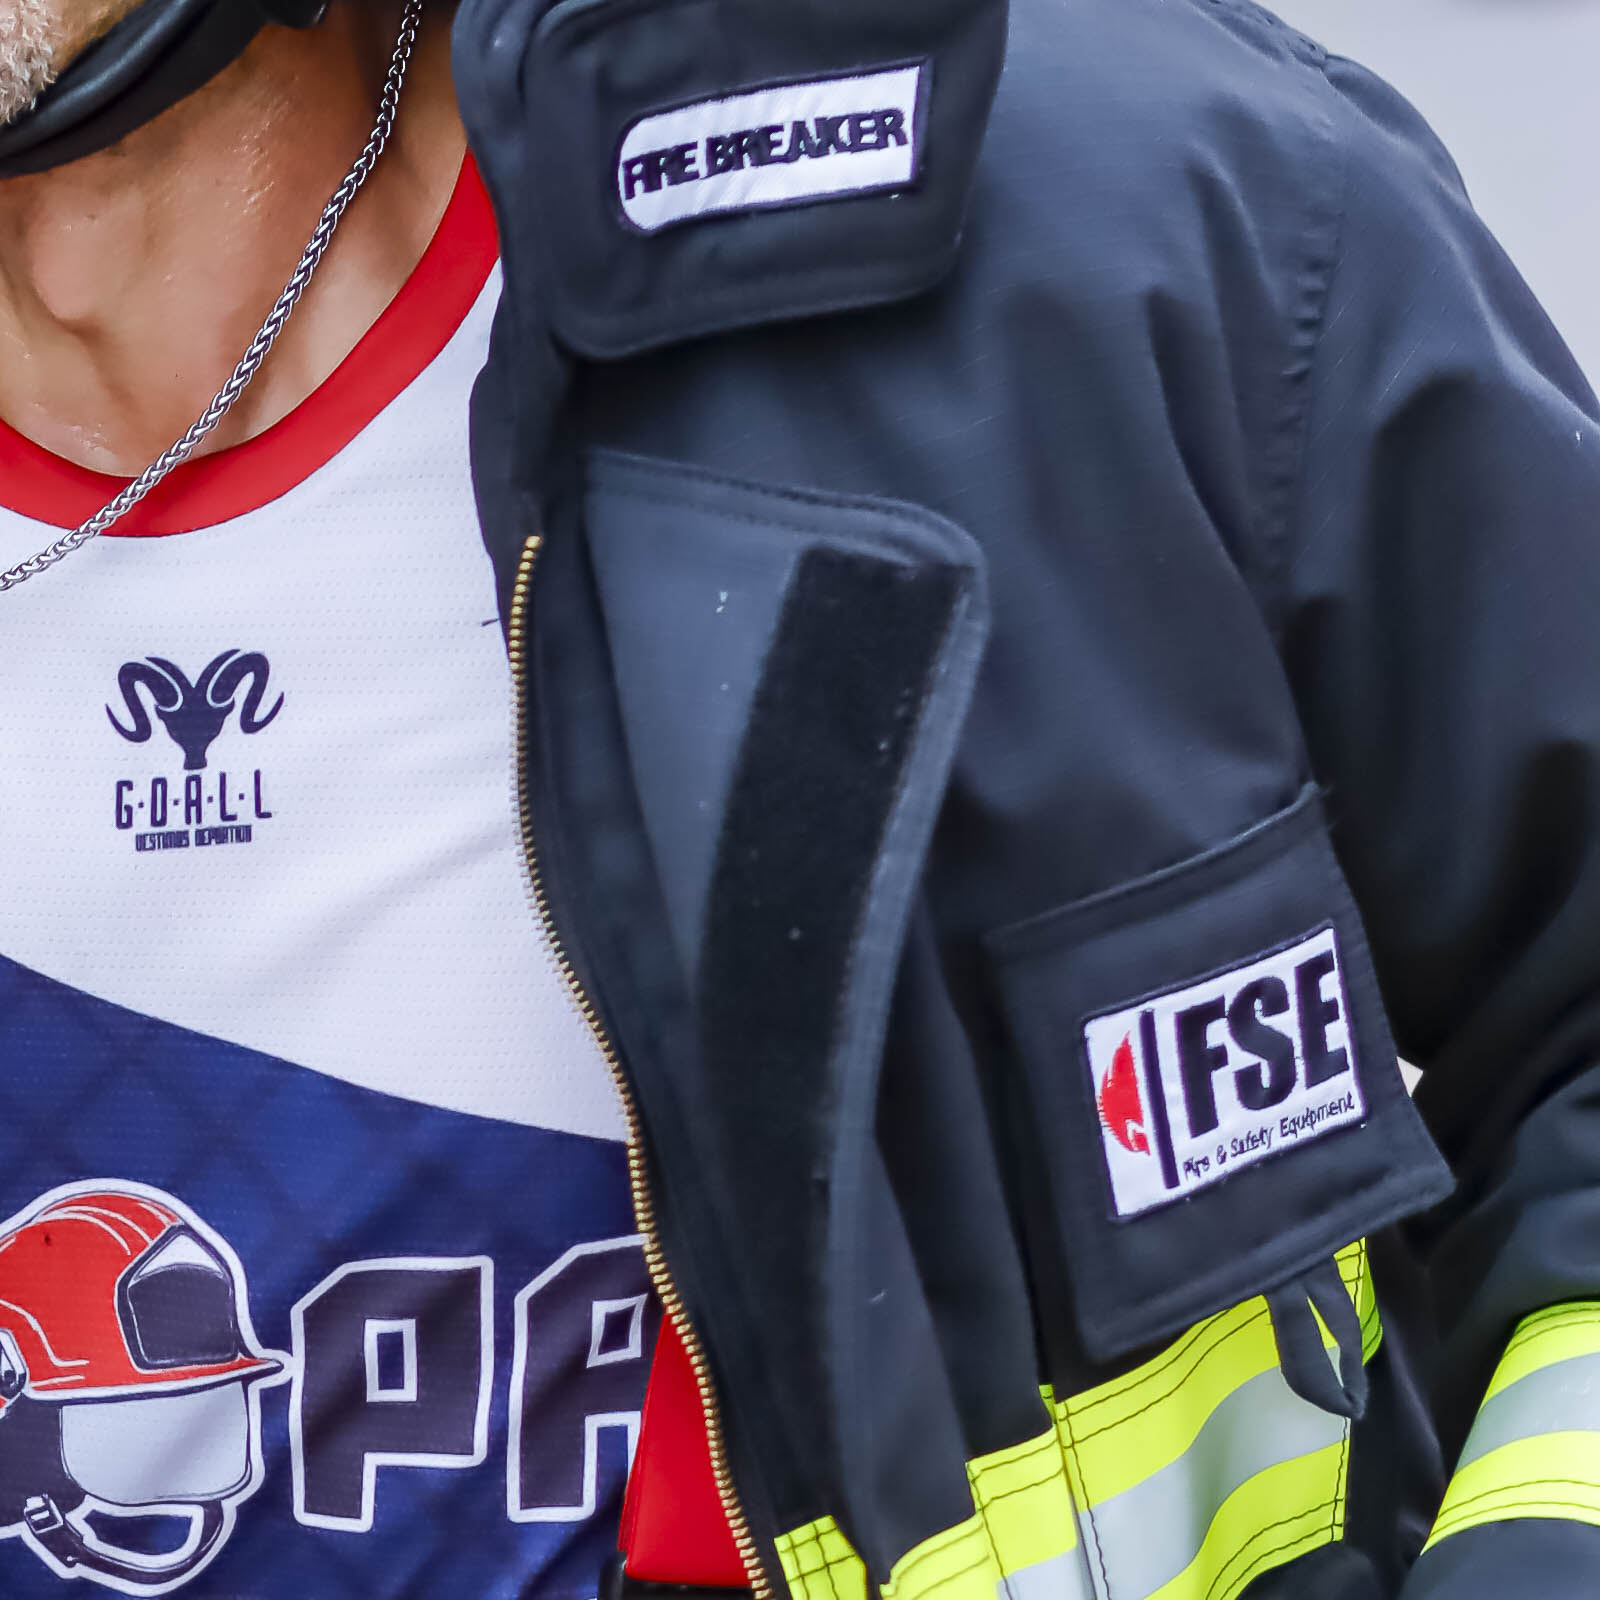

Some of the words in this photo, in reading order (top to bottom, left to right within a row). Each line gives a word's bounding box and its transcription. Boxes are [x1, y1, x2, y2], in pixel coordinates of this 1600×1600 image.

[705, 107, 908, 178] BREAKER
[1175, 949, 1350, 1139] FSE
[1230, 1126, 1274, 1158] Safety
[1279, 1091, 1356, 1139] Equipment
